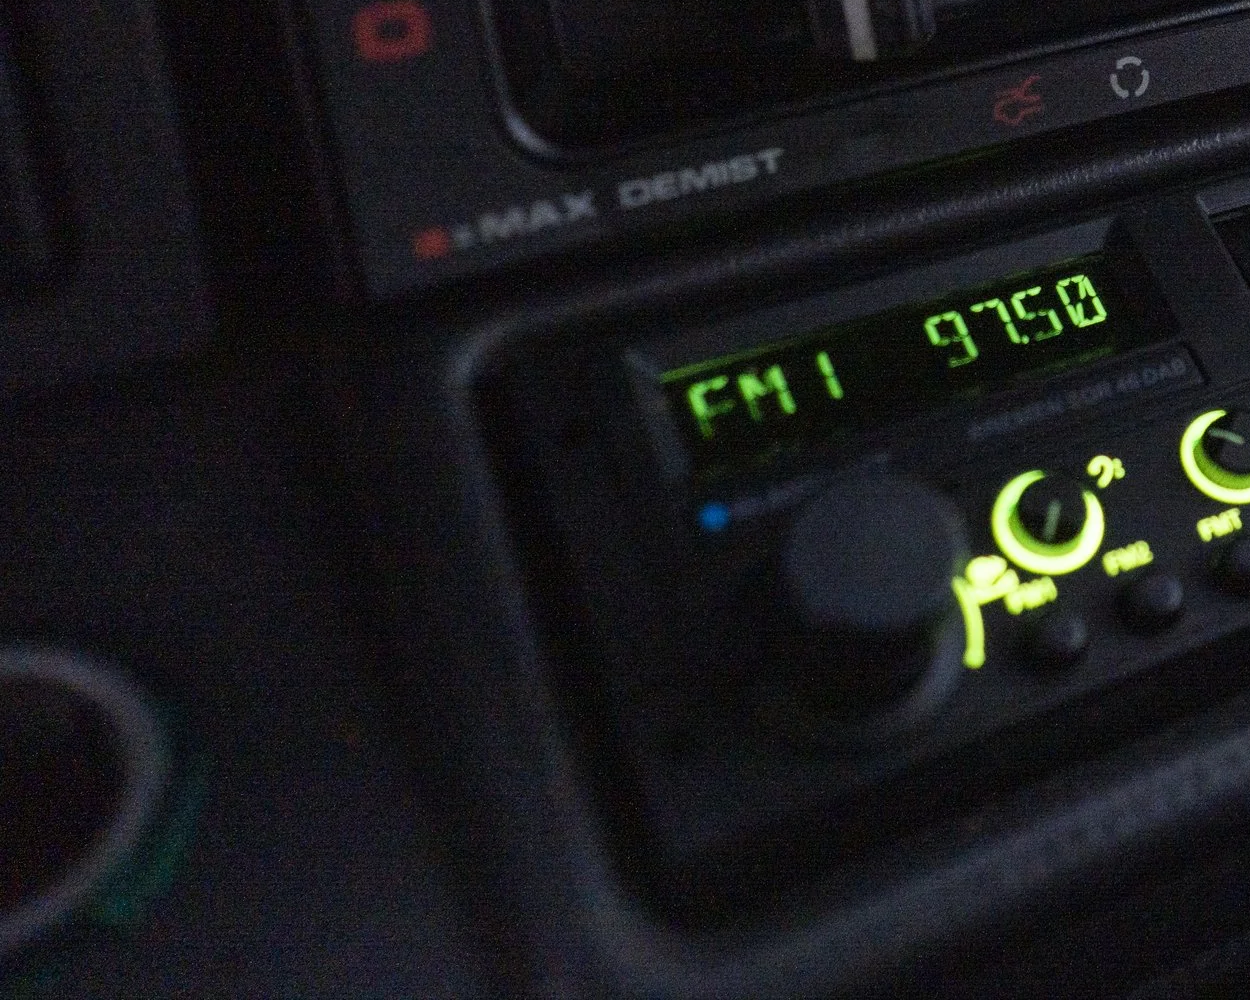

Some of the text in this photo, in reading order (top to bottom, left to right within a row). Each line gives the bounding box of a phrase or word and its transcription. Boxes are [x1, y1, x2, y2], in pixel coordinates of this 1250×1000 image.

[477, 147, 785, 245] MAX DEMIST
[1141, 355, 1187, 385] DAB
